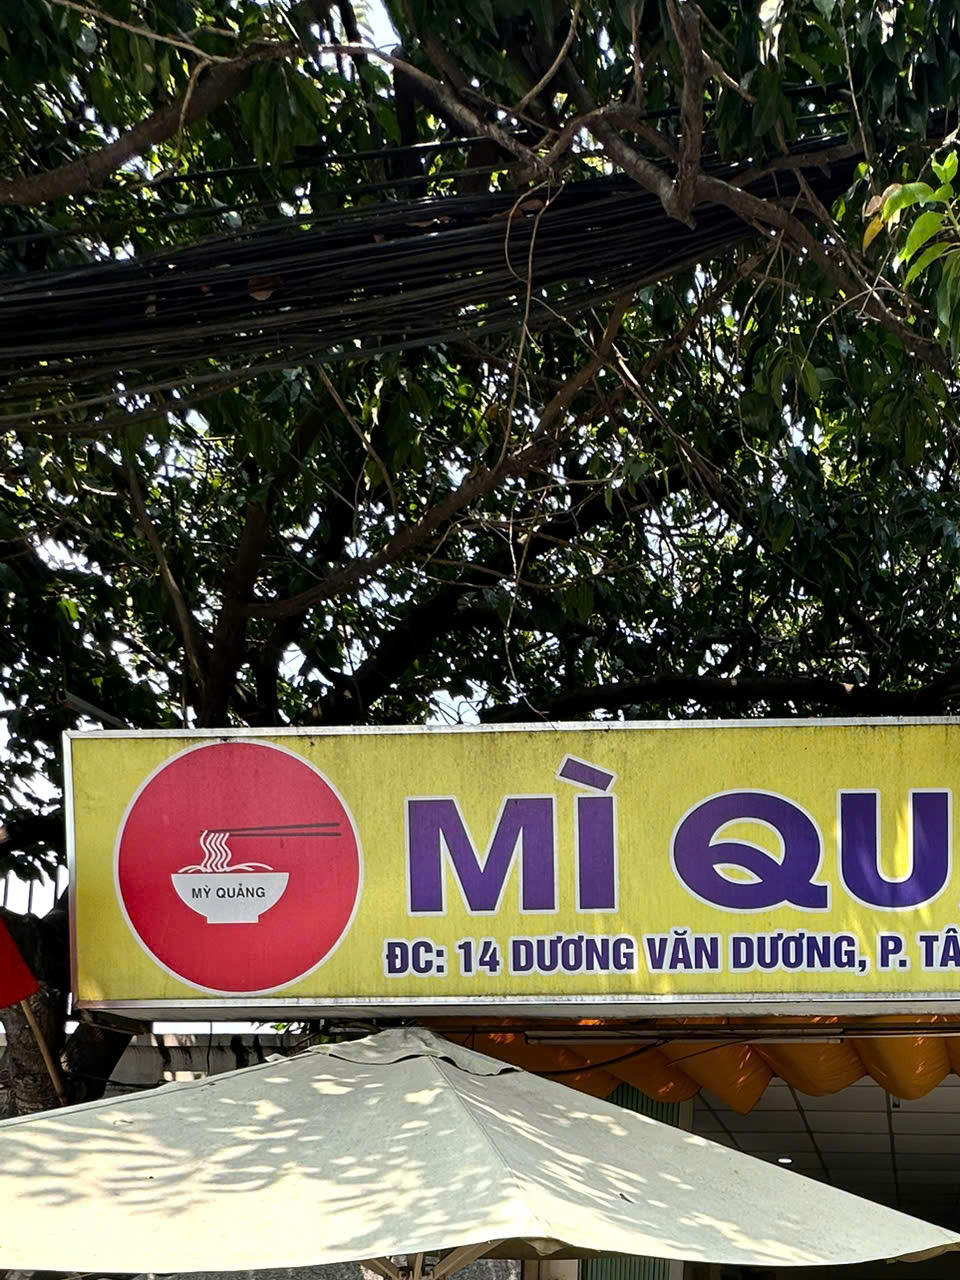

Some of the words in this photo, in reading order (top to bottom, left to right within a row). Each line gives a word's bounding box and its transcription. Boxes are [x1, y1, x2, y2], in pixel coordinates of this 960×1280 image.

[407, 756, 616, 912] MÌ
[216, 883, 265, 899] QUẢNG
[386, 941, 445, 975] ĐC:
[458, 941, 500, 974] 14
[512, 935, 635, 973] DƯƠNG
[646, 930, 719, 970] VĂN
[732, 931, 868, 973] DƯƠNG,
[880, 934, 908, 968] P.
